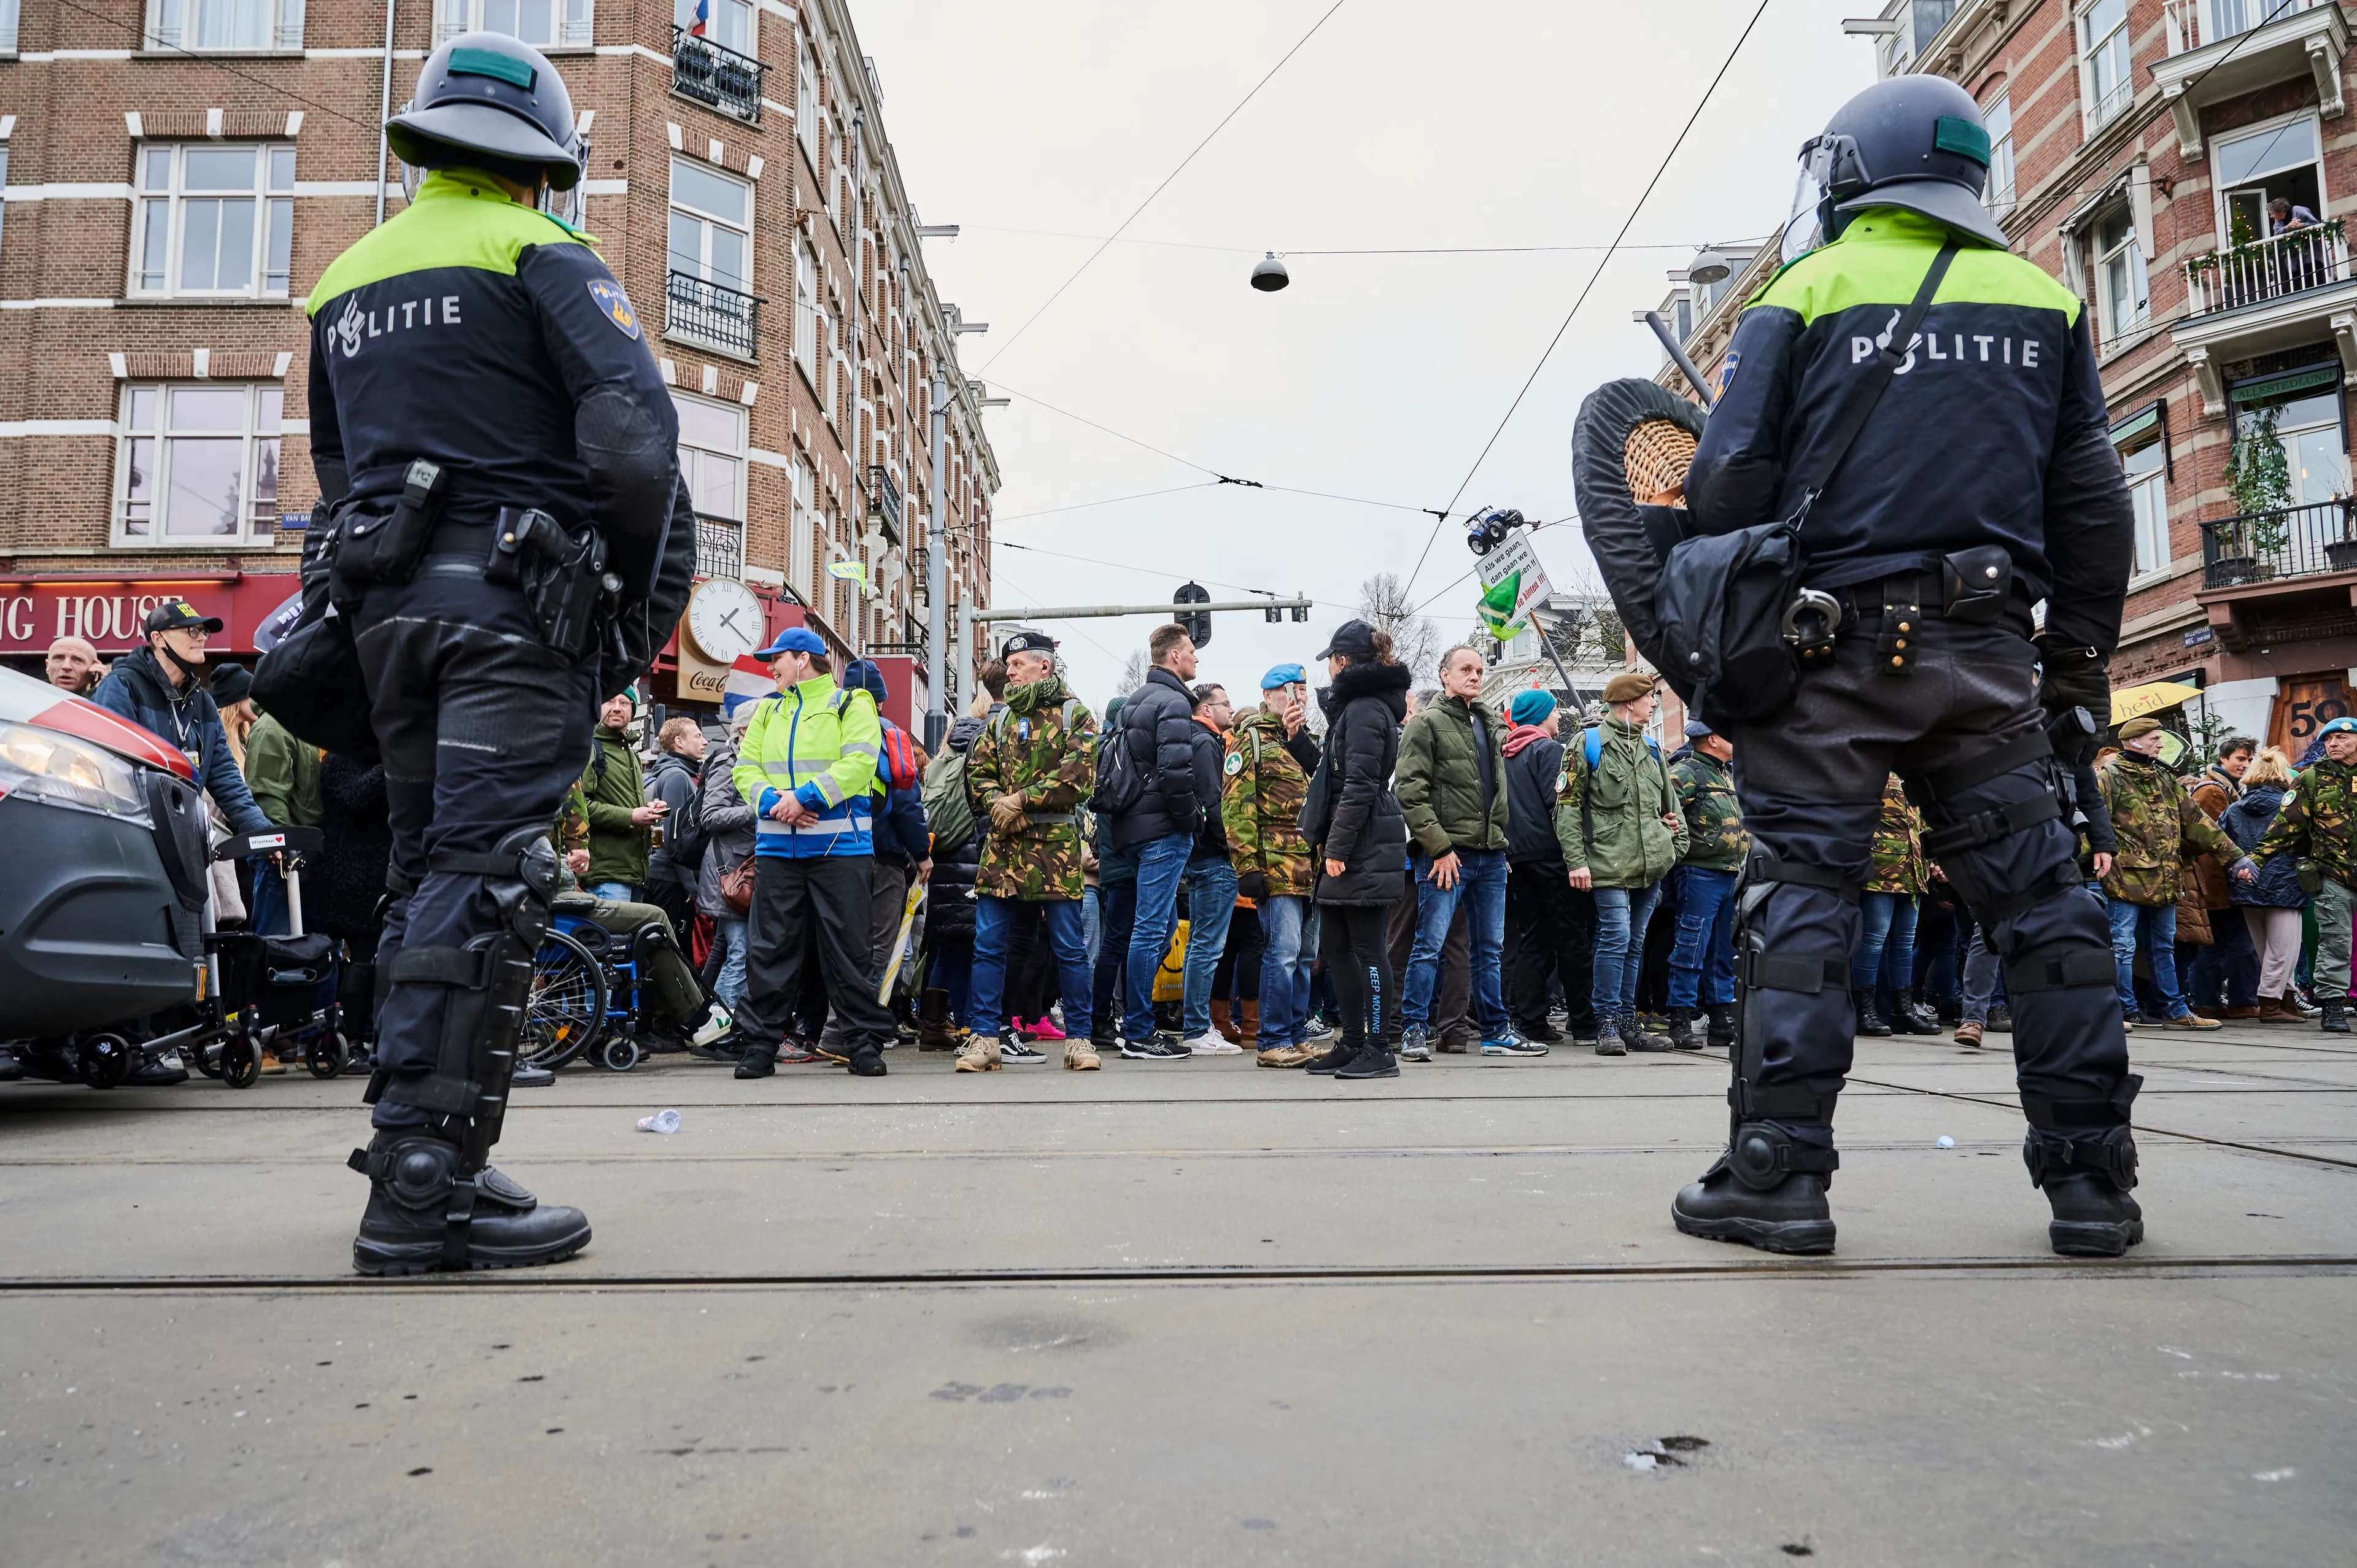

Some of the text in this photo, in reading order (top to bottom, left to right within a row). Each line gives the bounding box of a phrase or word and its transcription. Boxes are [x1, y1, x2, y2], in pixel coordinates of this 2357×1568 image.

[327, 293, 462, 358] POLITIE
[2238, 371, 2332, 400] ALLESTEDLUND
[2110, 419, 2145, 442] STEDLUND
[1484, 540, 1522, 573] Als we gaan,
[1490, 550, 1528, 584] dan gaan we
[1521, 564, 1531, 576] en
[706, 584, 716, 595] XI
[722, 582, 732, 593] XII
[1522, 581, 1539, 601] kloten
[695, 595, 704, 604] X
[0, 595, 184, 641] G HOUS
[690, 611, 700, 621] IX
[751, 621, 761, 630] III
[703, 641, 714, 655] VII
[721, 649, 729, 660] VI
[689, 671, 729, 693] Coca-C
[1369, 966, 1380, 1033] KEEP MOVING
